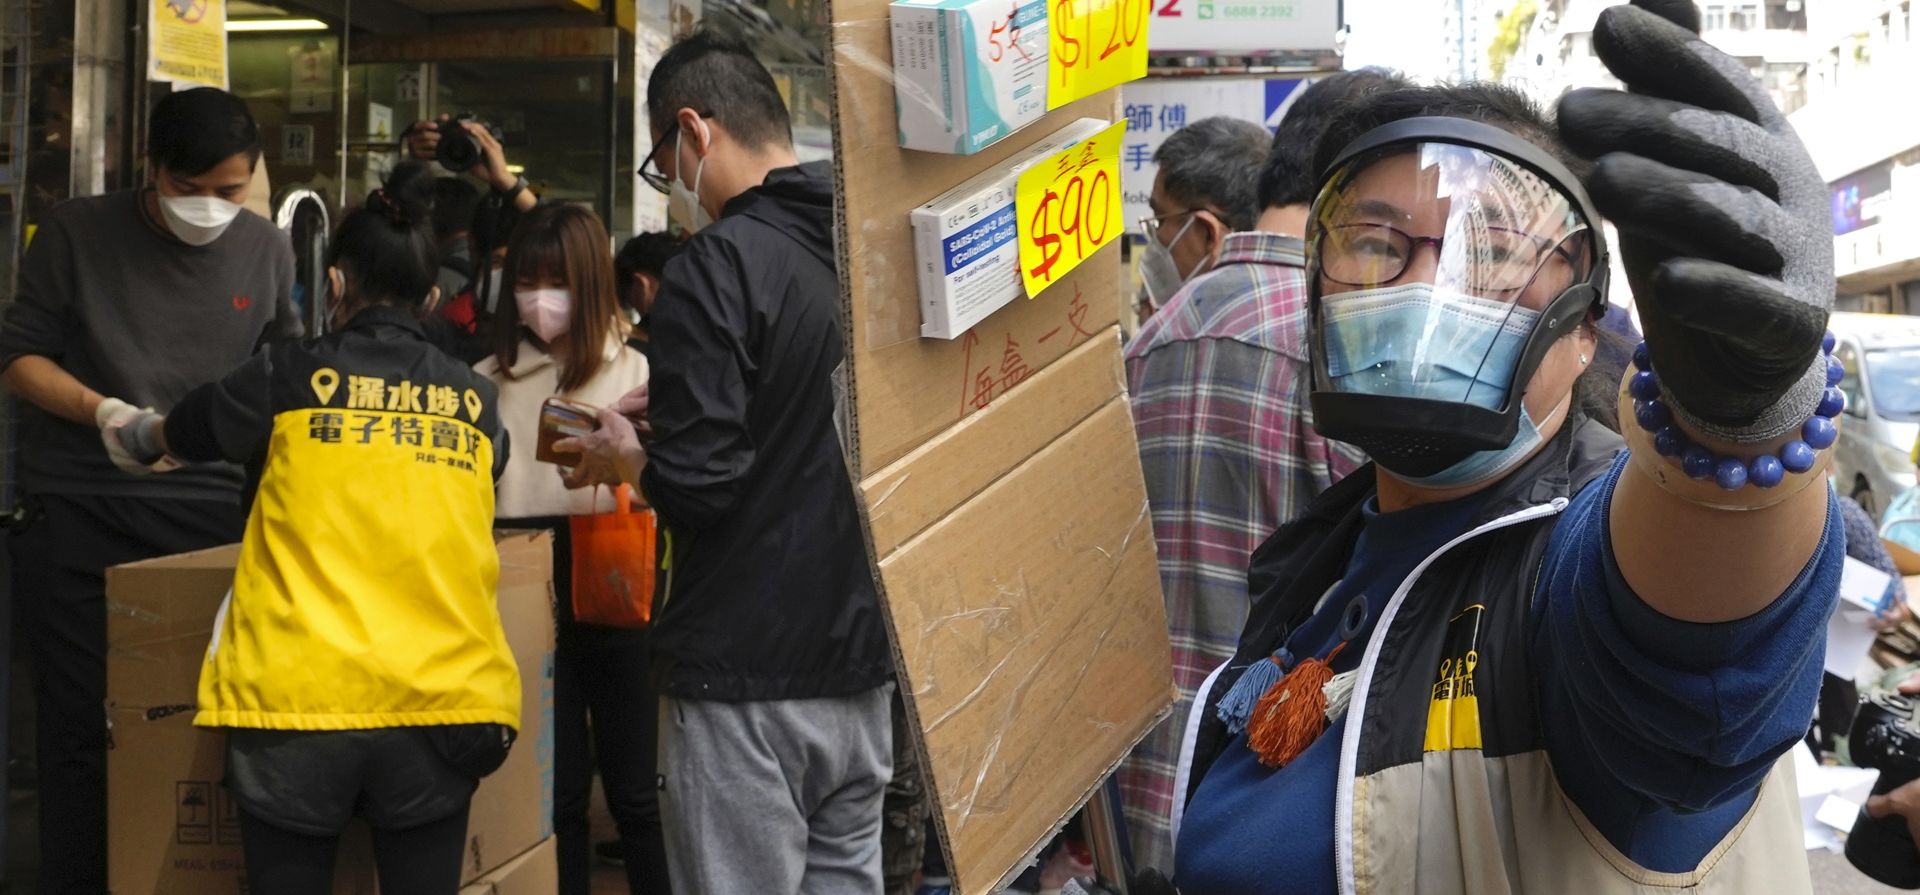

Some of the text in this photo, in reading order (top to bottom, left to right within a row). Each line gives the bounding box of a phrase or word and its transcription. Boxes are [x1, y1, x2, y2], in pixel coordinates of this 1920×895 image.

[1150, 0, 1182, 17] 2
[1054, 0, 1143, 87] $120
[949, 219, 998, 253] SARS-CoV-2
[1030, 169, 1110, 282] $90
[951, 235, 993, 269] (Colloidal
